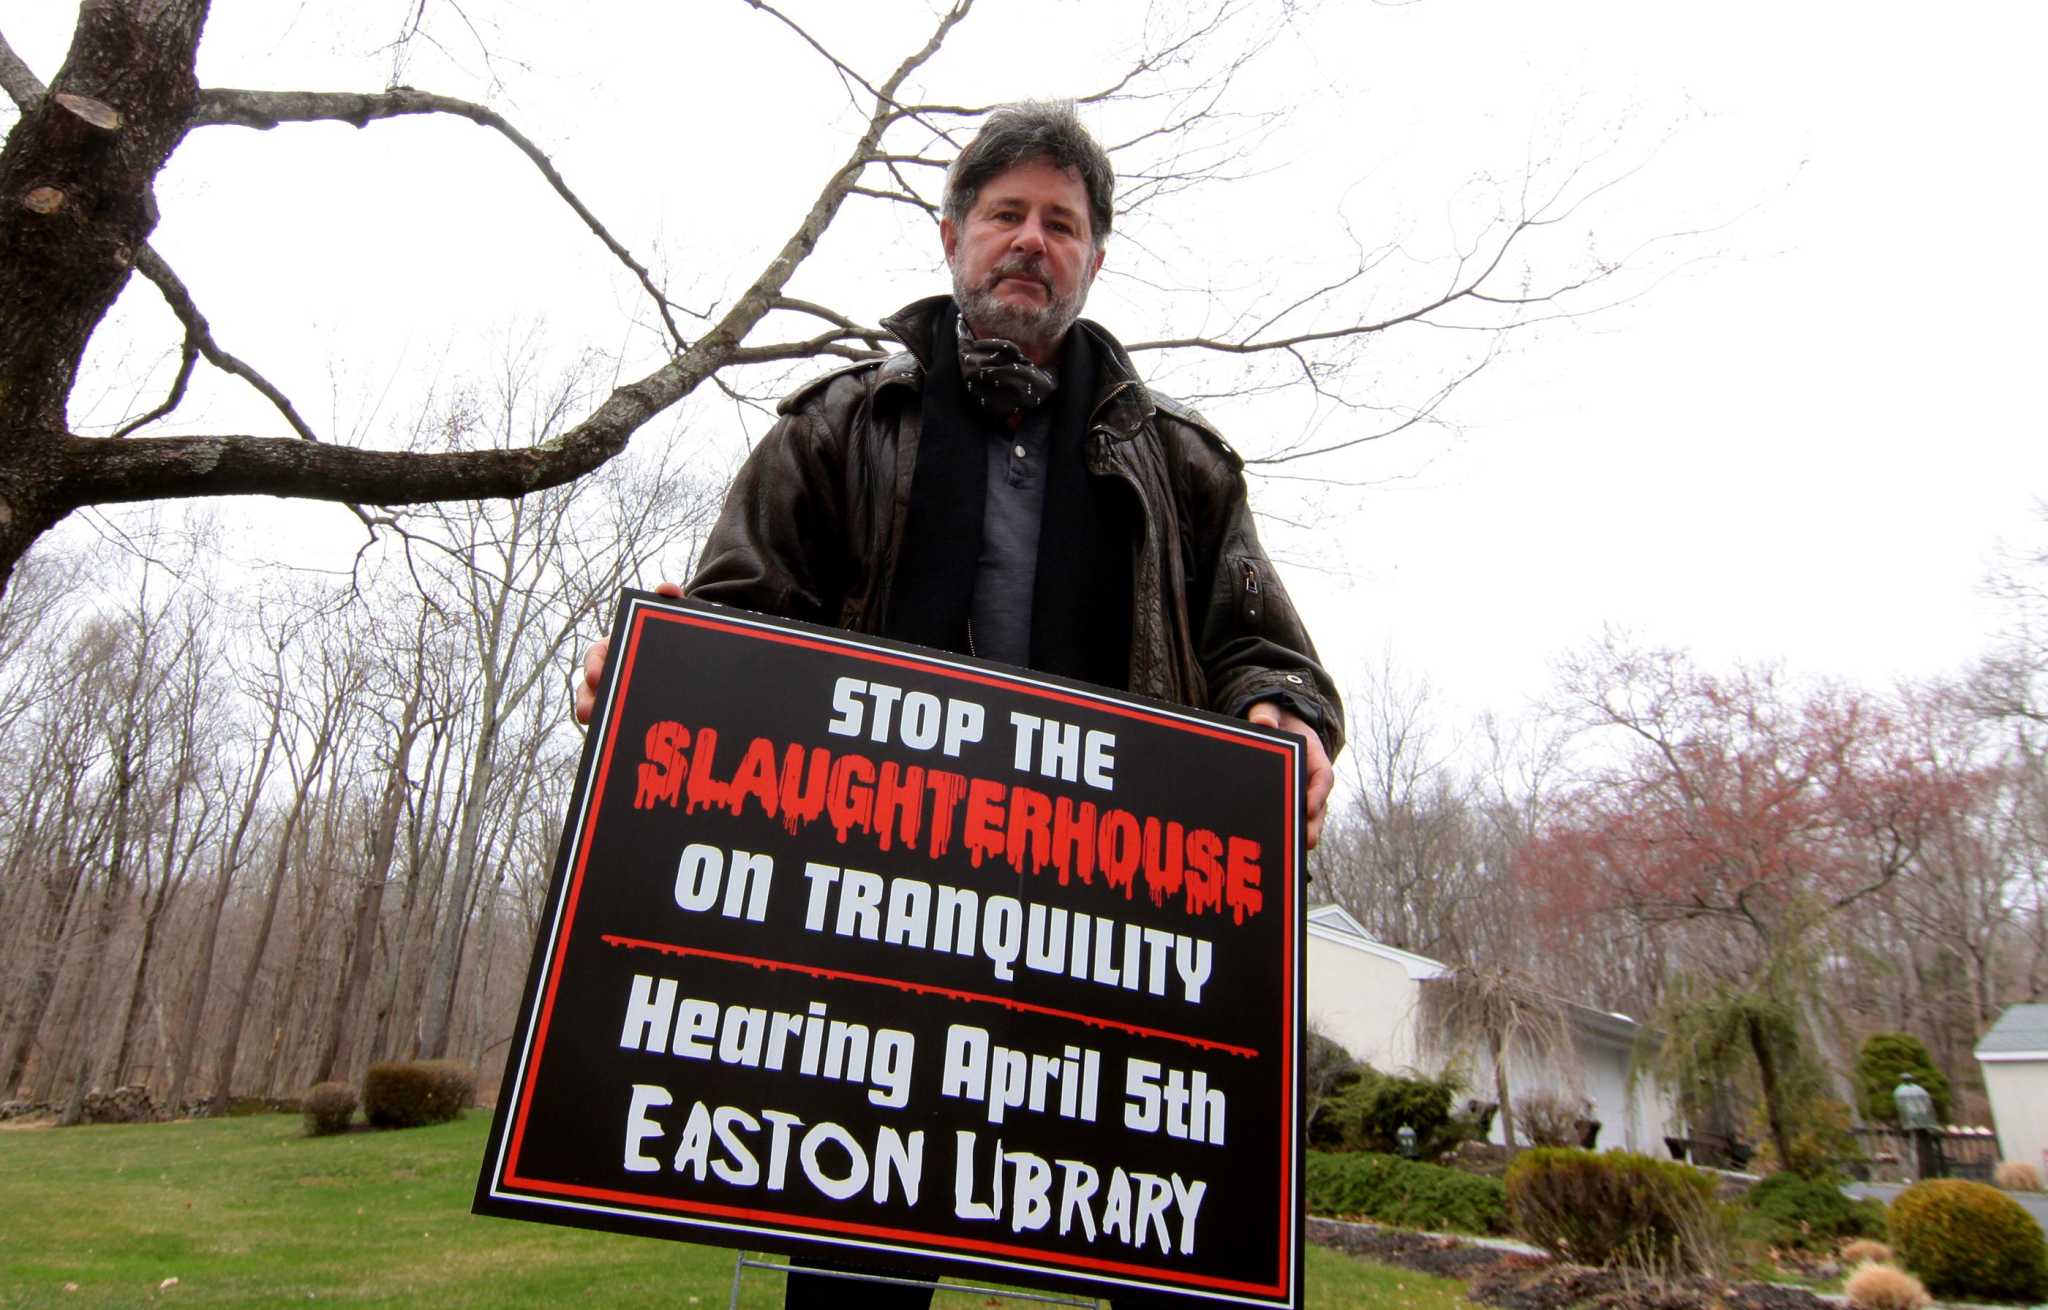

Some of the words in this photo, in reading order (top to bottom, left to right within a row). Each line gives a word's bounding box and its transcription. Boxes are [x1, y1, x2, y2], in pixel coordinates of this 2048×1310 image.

[828, 677, 985, 757] STOP
[1010, 712, 1115, 790] THE
[634, 721, 1262, 925] SLAUGHTERHOUSE
[620, 975, 914, 1108] Hearing
[942, 1025, 1100, 1123] April
[1125, 1058, 1225, 1145] 5th
[624, 1085, 924, 1206] EASTON
[955, 1131, 1206, 1254] LIBRARY
